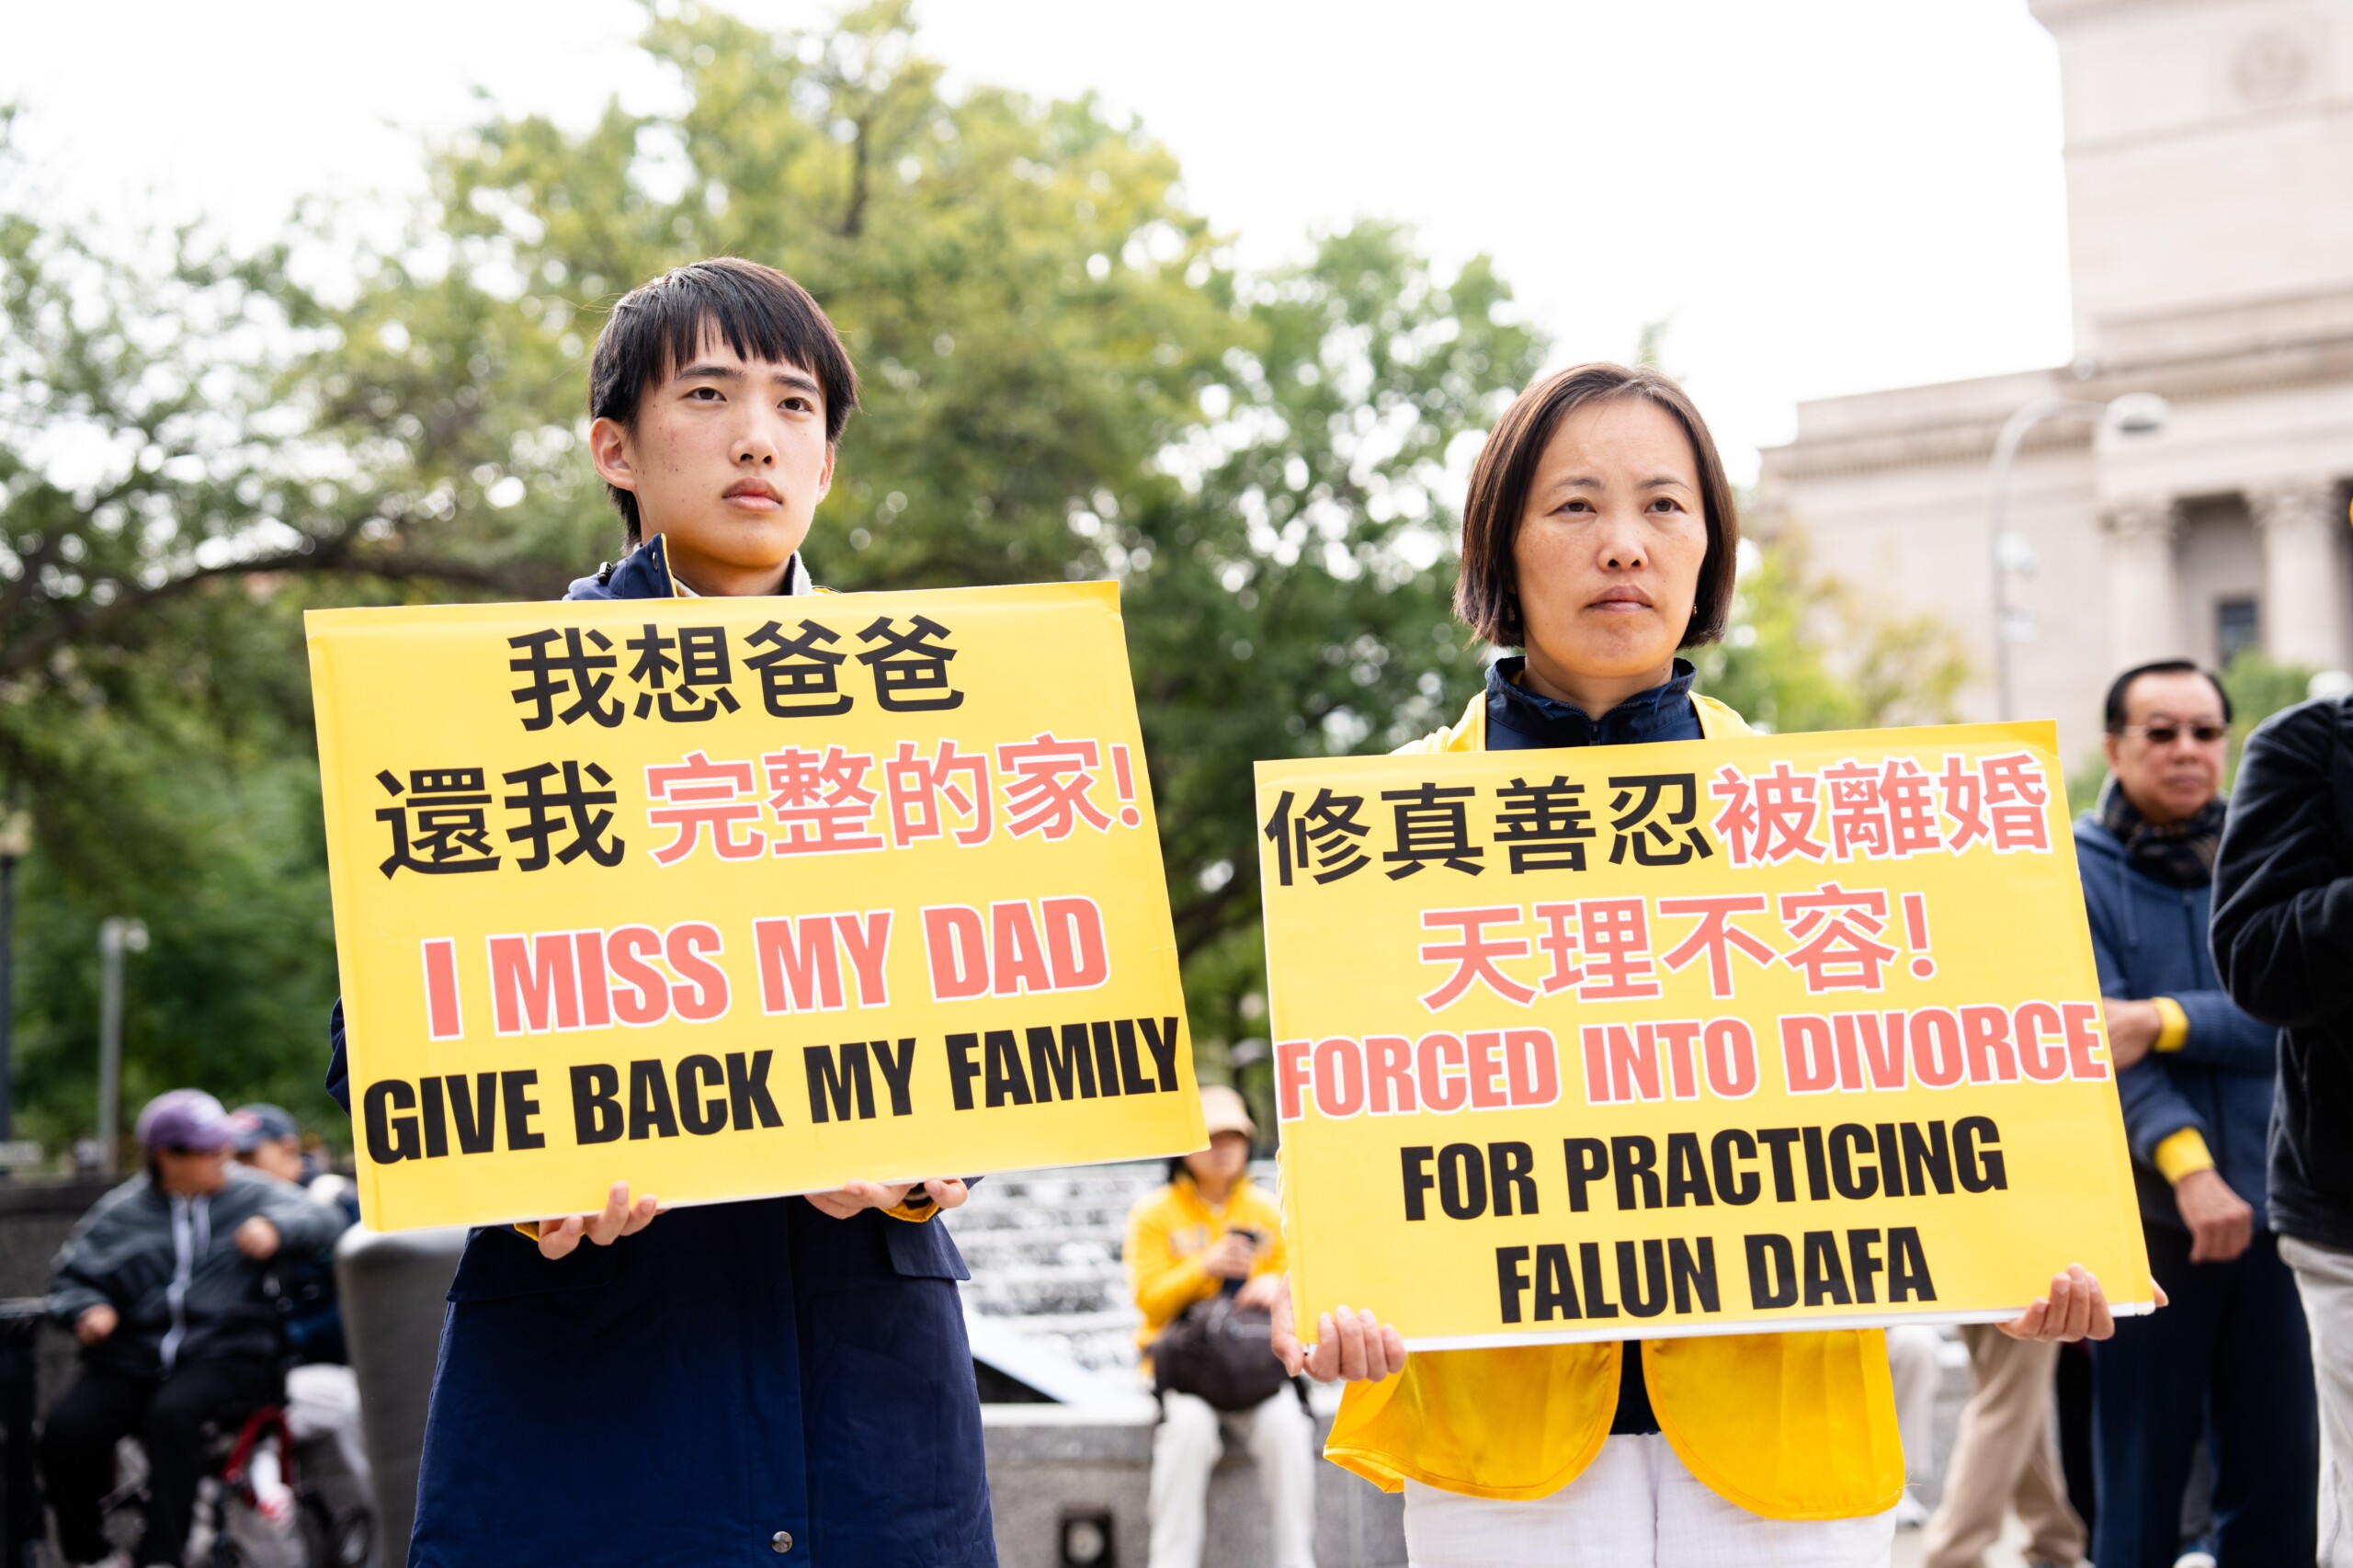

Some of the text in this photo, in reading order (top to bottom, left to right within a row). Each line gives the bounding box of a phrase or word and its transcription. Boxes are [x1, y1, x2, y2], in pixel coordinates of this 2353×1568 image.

[507, 614, 965, 732] 我想爸爸
[420, 895, 1111, 1040] I MISS MY DAD
[1418, 881, 1938, 1013] 天理不容!
[367, 1017, 1179, 1165] GIVE BACK MY FAMILY
[1277, 1001, 2109, 1121] FORCED INTO DIVORCE
[1400, 1116, 2008, 1221] FOR PRACTICING
[1496, 1226, 1938, 1324] FALUN DAFA
